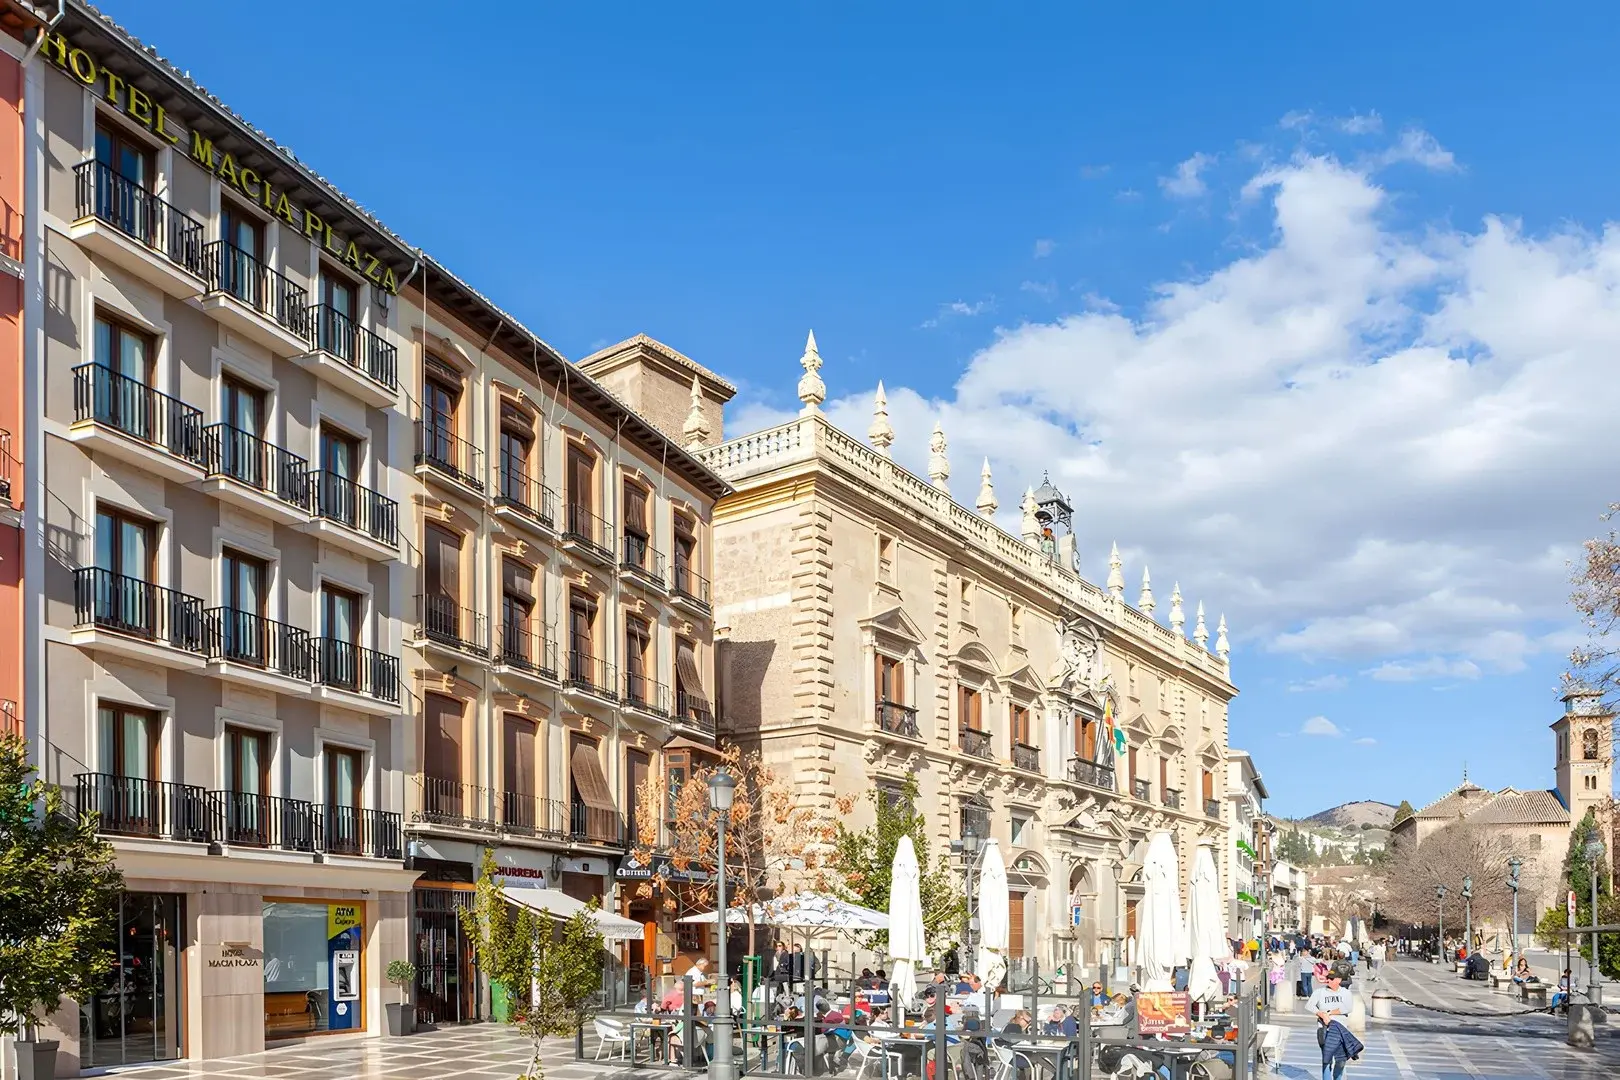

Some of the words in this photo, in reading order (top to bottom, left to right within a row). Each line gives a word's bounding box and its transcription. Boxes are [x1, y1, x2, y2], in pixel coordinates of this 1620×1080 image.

[39, 32, 179, 144] HOTEL
[191, 130, 293, 224] MACIA
[304, 209, 397, 295] PLAZA
[335, 907, 355, 917] ATM
